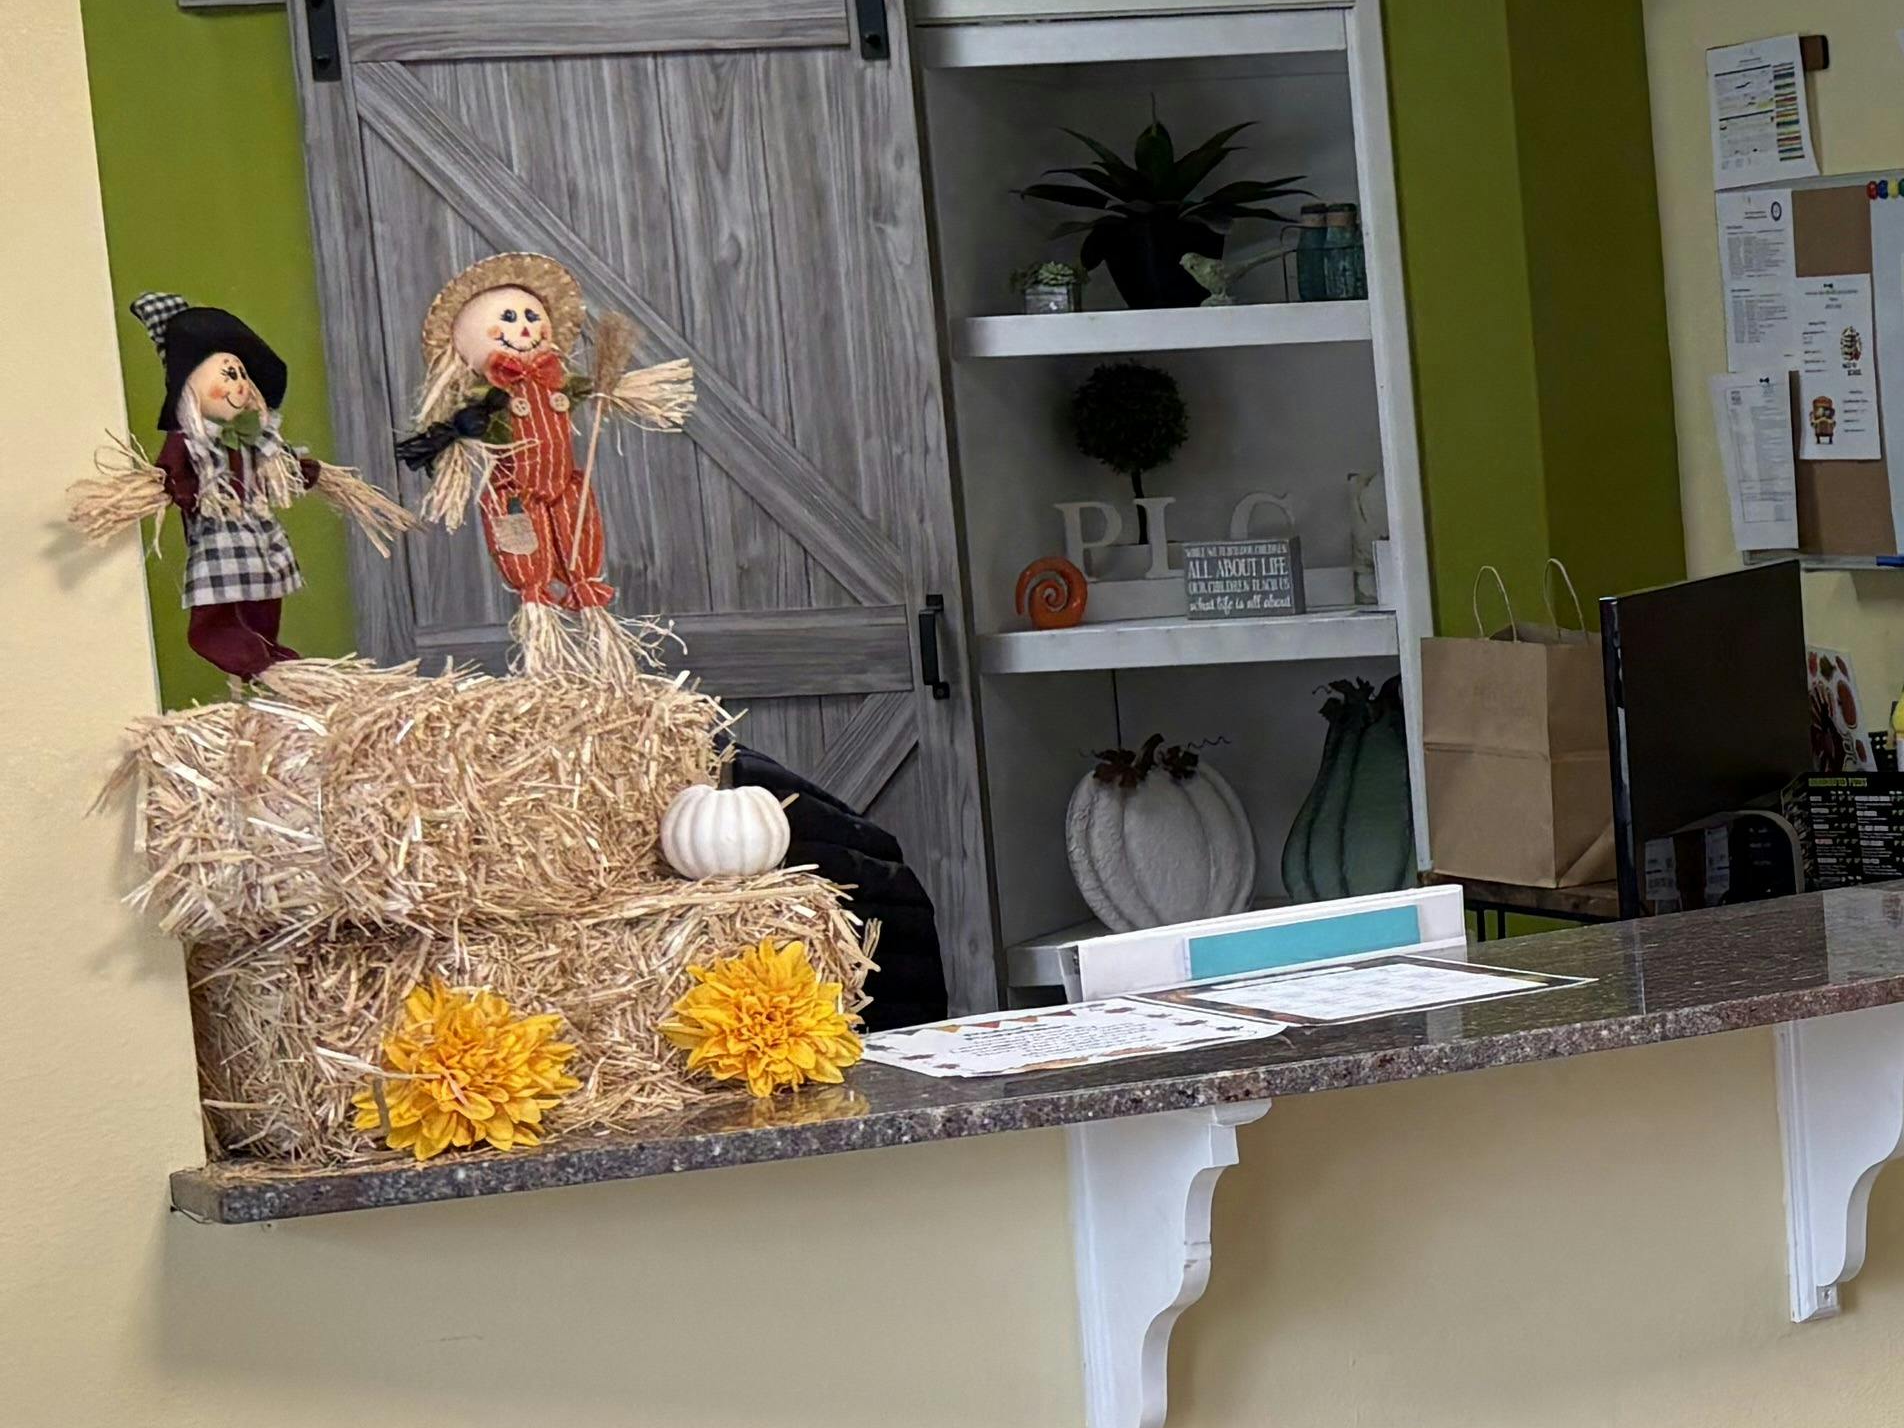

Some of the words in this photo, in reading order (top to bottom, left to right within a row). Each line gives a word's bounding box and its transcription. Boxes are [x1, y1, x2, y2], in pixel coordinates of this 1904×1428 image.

[1188, 559, 1213, 579] ALL
[1216, 558, 1257, 578] ABOUT
[1261, 557, 1288, 576] LIFE
[1188, 580, 1208, 594] OUR
[1208, 579, 1250, 593] CHILDREN
[1252, 578, 1278, 591] TEACH
[1189, 597, 1215, 611] what
[1216, 595, 1234, 616] life
[1235, 598, 1244, 609] is
[1246, 594, 1262, 609] all
[1263, 593, 1291, 608] about
